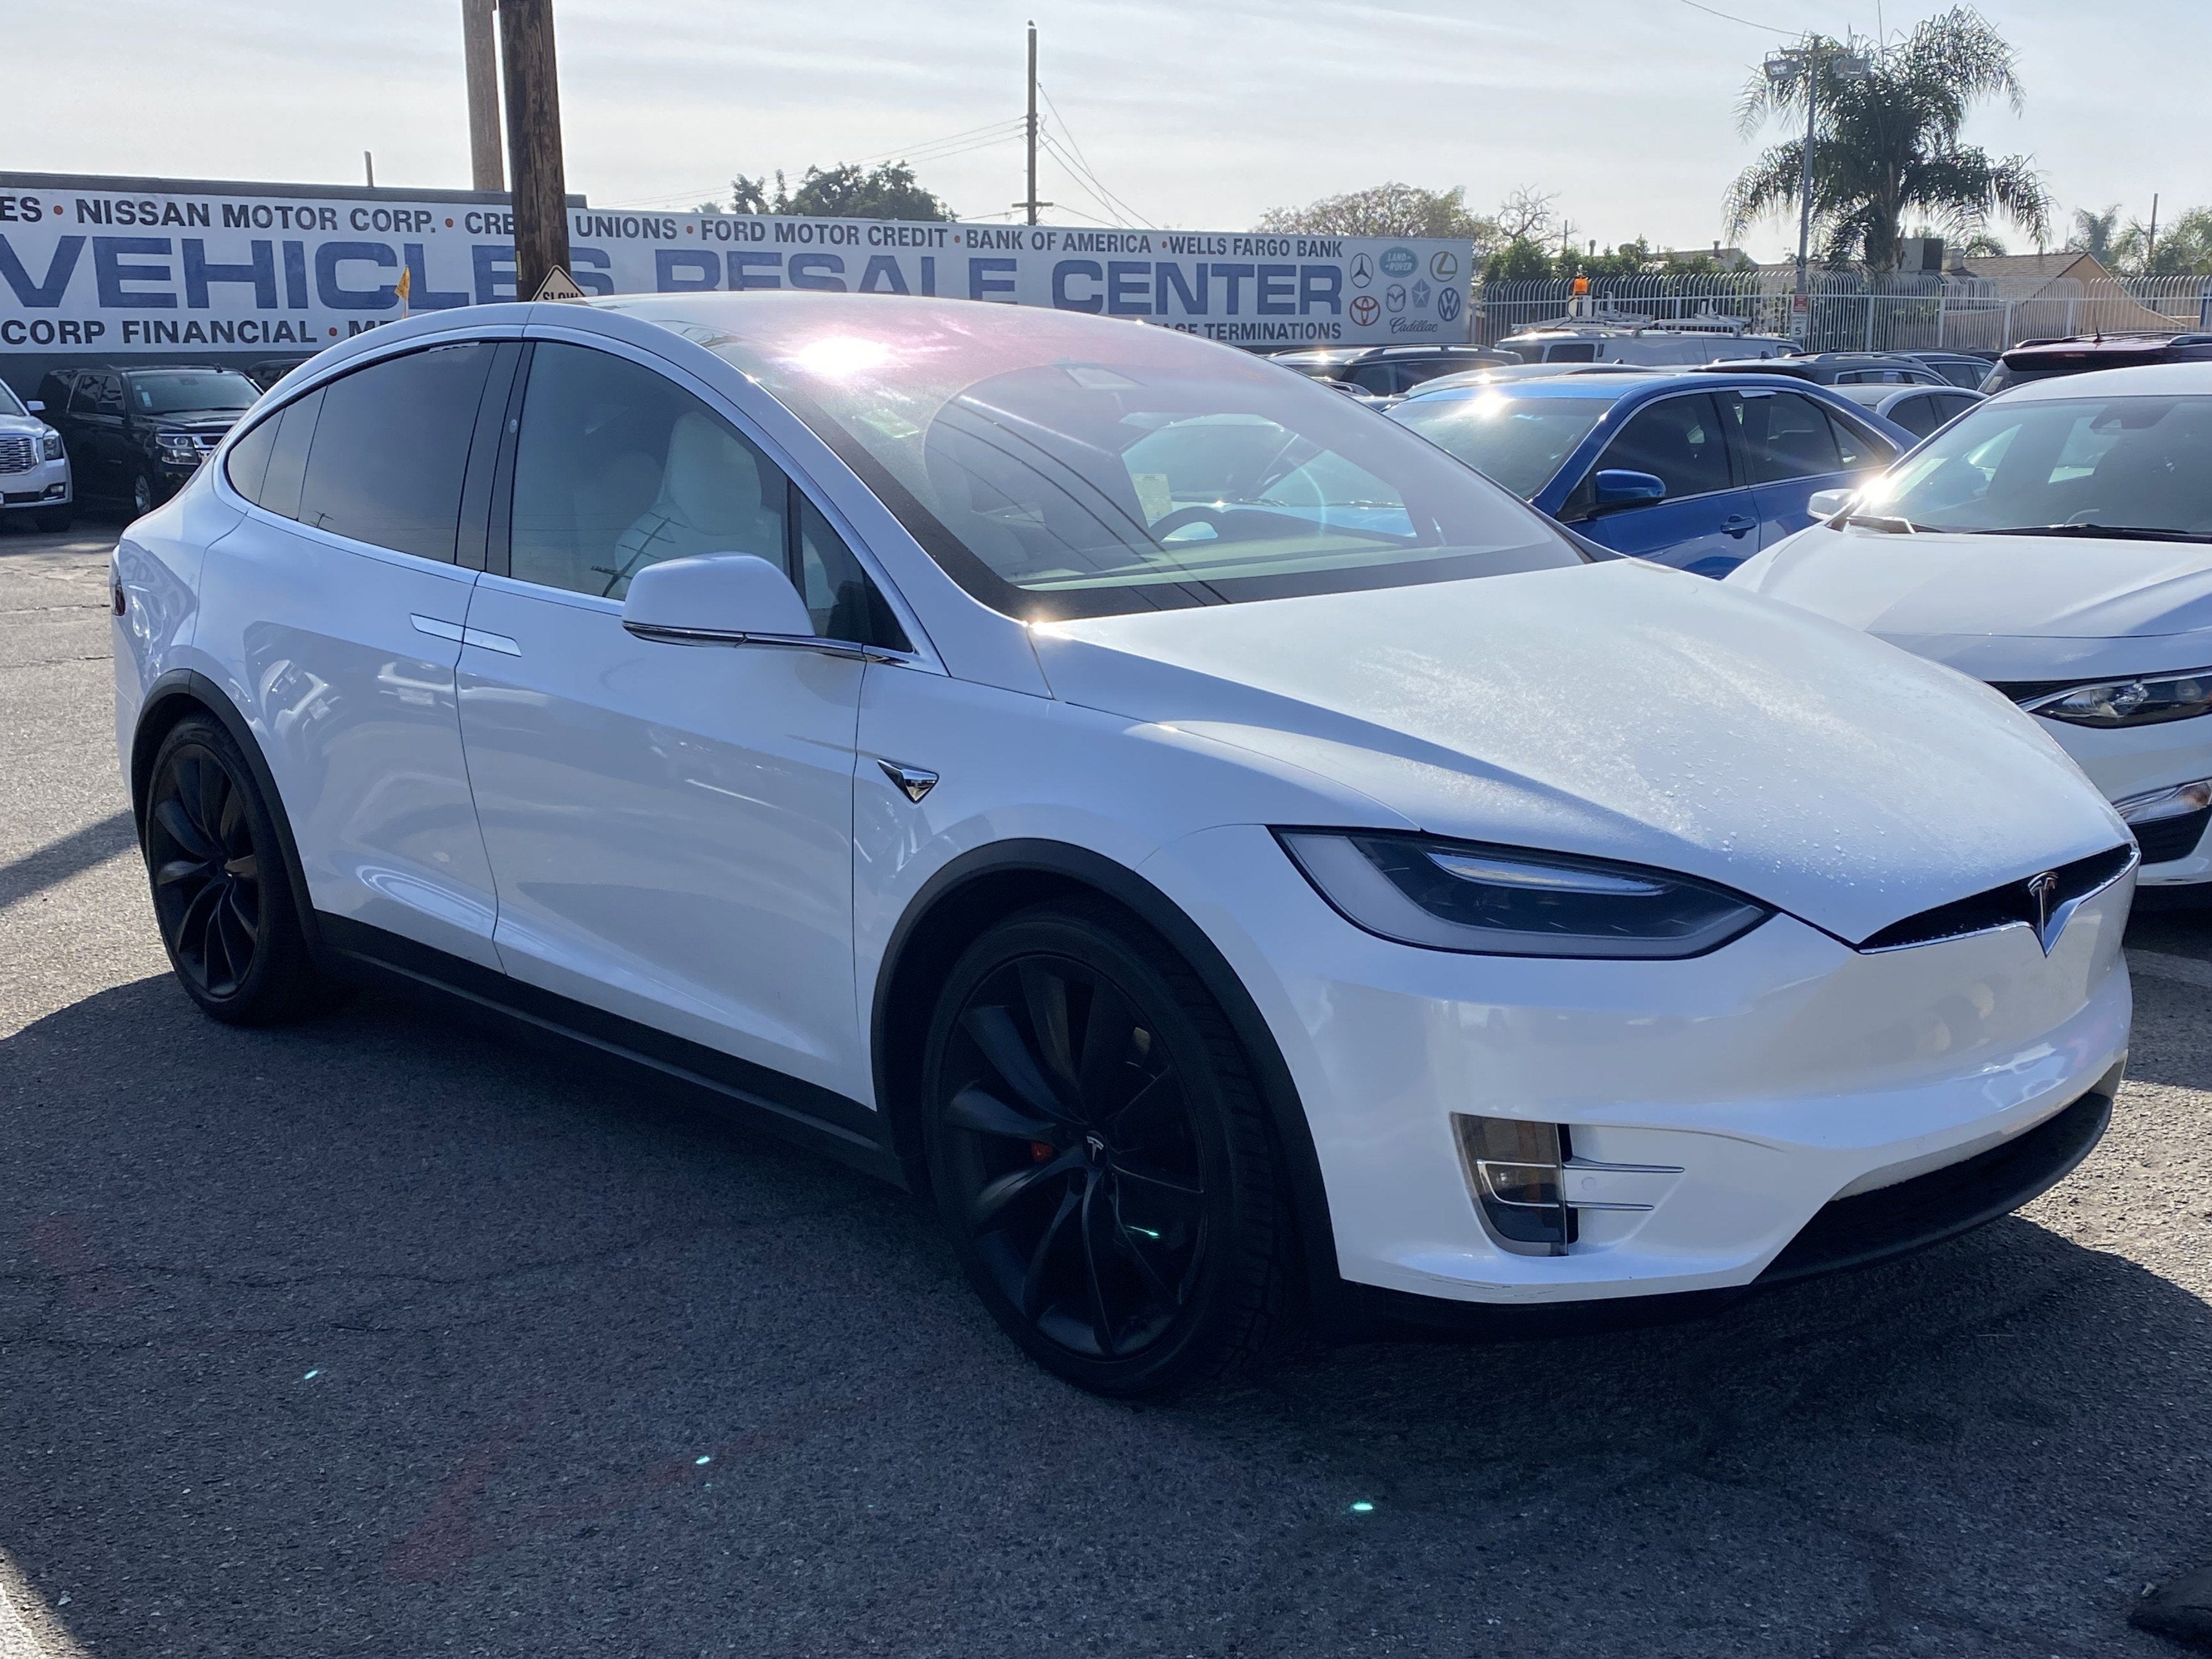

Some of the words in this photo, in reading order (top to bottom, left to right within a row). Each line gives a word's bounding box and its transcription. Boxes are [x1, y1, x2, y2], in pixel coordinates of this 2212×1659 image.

[76, 199, 210, 227] NISSAN
[223, 204, 338, 230] MOTOR
[350, 207, 436, 234] CORP.
[465, 212, 514, 235] CRE
[576, 216, 677, 239] UNIONS
[701, 219, 766, 242] FORD
[775, 223, 860, 245] MOTOR
[868, 227, 948, 248] CREDIT
[967, 229, 1024, 250] BANK
[1031, 231, 1057, 250] OF
[1062, 232, 1152, 253] AMERICA
[1169, 236, 1227, 256] WELLS
[1233, 238, 1290, 257] FARGO
[1297, 240, 1343, 258] BANK
[0, 234, 615, 310] VEHICLES
[655, 249, 1018, 305] RESALE
[1052, 260, 1343, 315] CENTER
[1, 320, 105, 345] CORP
[123, 321, 317, 344] FINANCIAL
[1204, 323, 1341, 340] TERMINATIONS
[1390, 316, 1438, 334] Cadillac
[1794, 327, 1801, 335] 5
